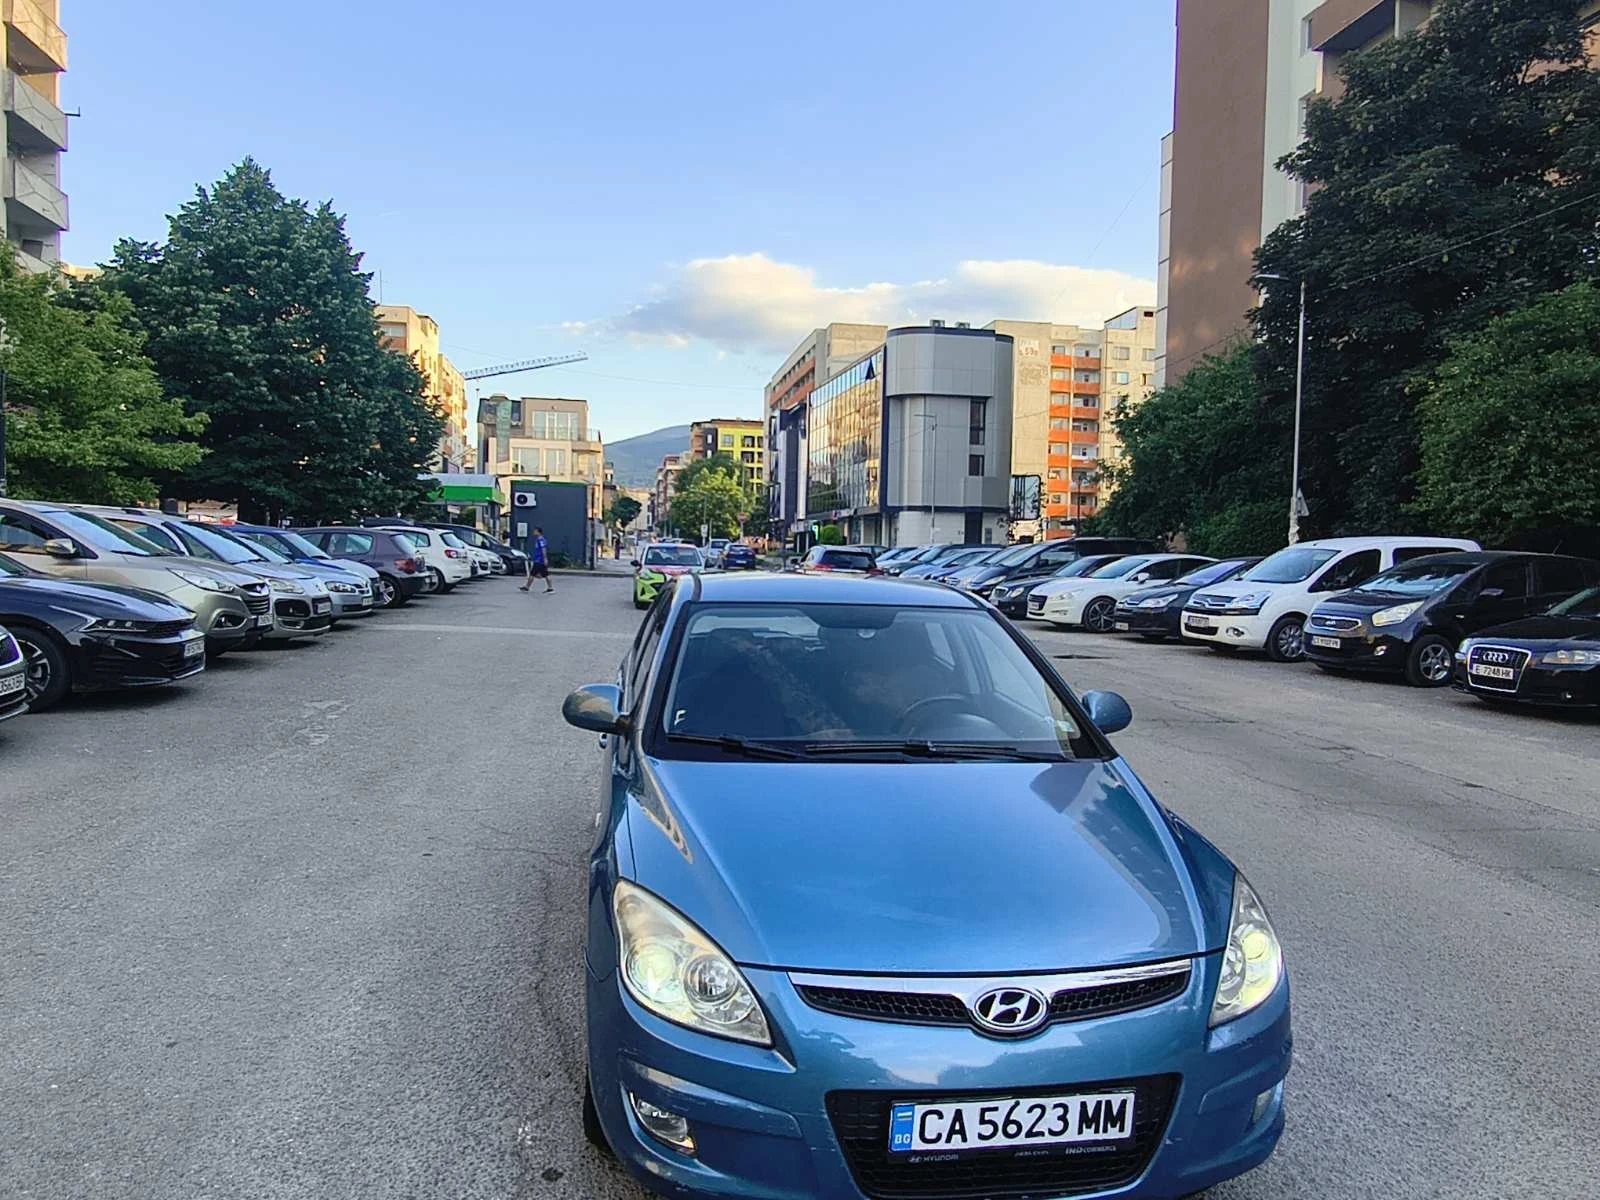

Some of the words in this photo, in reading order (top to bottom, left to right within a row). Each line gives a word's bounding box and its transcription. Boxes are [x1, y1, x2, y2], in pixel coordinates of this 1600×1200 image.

[918, 1109, 968, 1145] CA
[977, 1100, 1069, 1141] 5623
[1077, 1098, 1128, 1136] MM
[894, 1134, 911, 1144] BG
